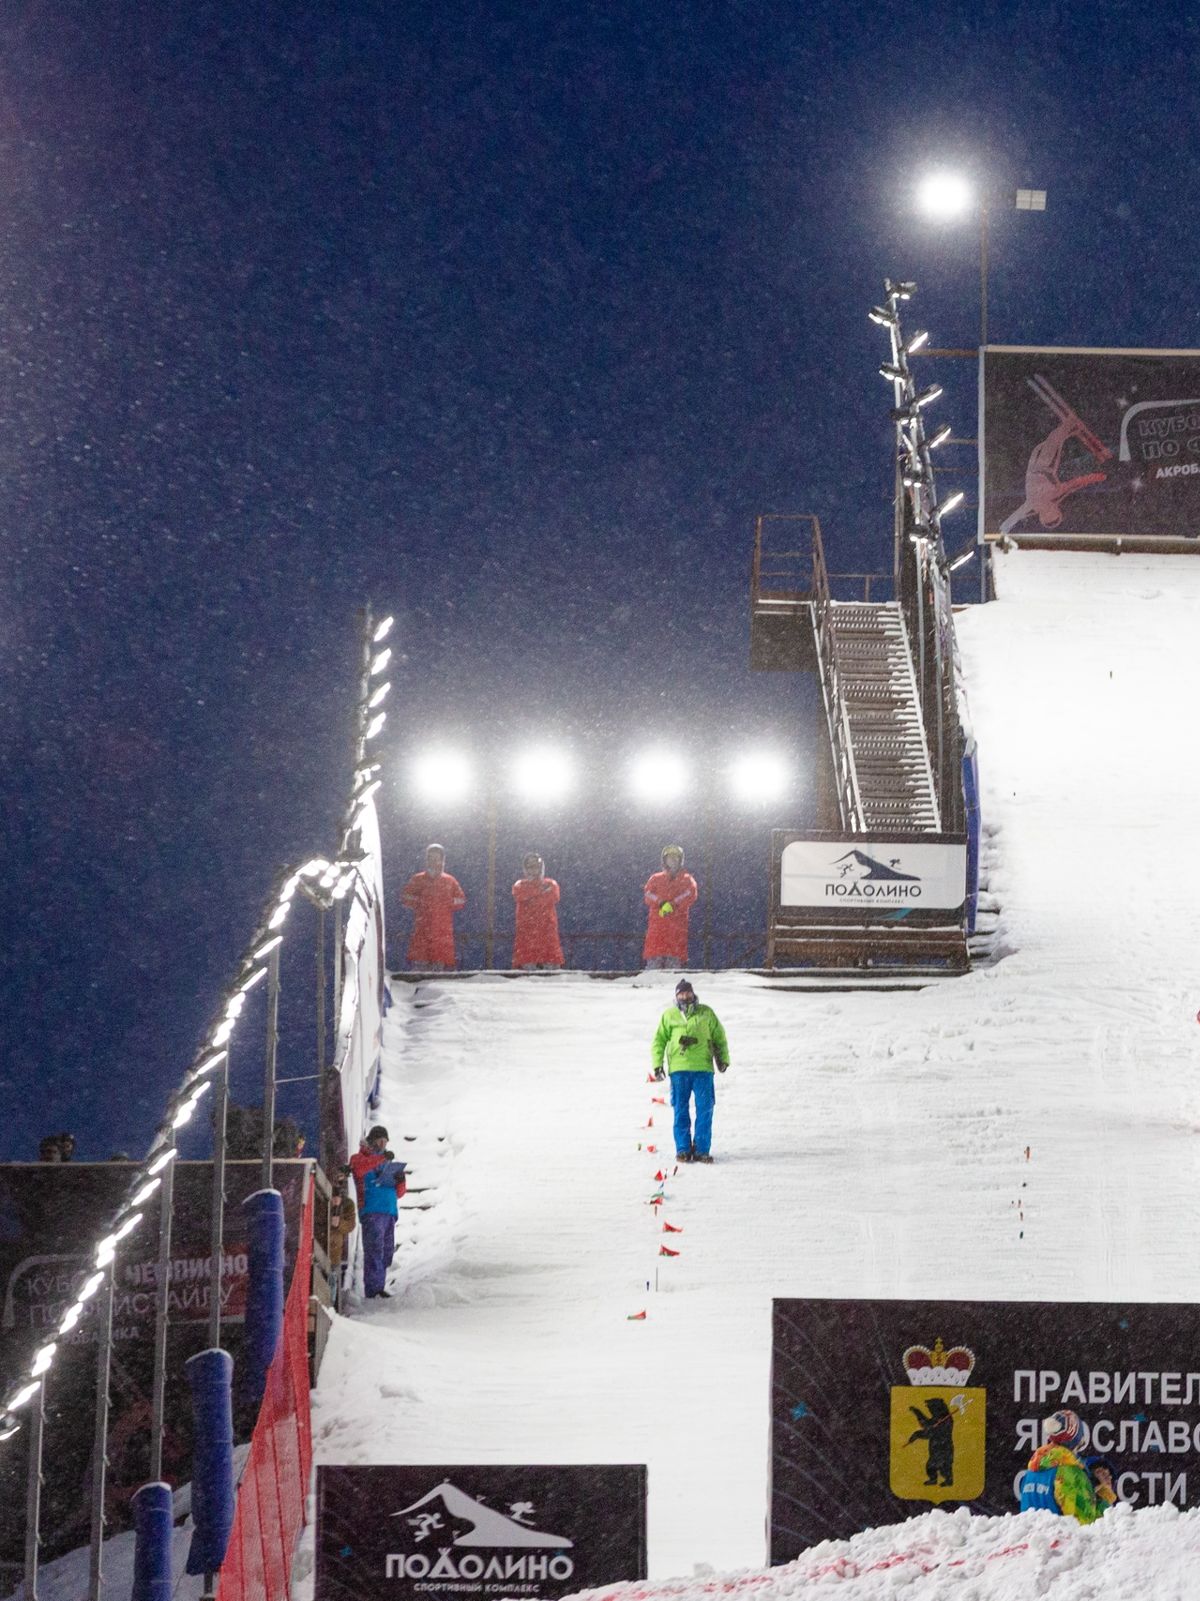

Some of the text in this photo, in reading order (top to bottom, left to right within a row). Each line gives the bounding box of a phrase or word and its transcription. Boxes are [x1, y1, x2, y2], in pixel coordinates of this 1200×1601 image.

[1142, 439, 1180, 459] ПО
[825, 880, 922, 897] ПОДОЛИНО
[385, 1547, 574, 1580] ПОДОЛИНО
